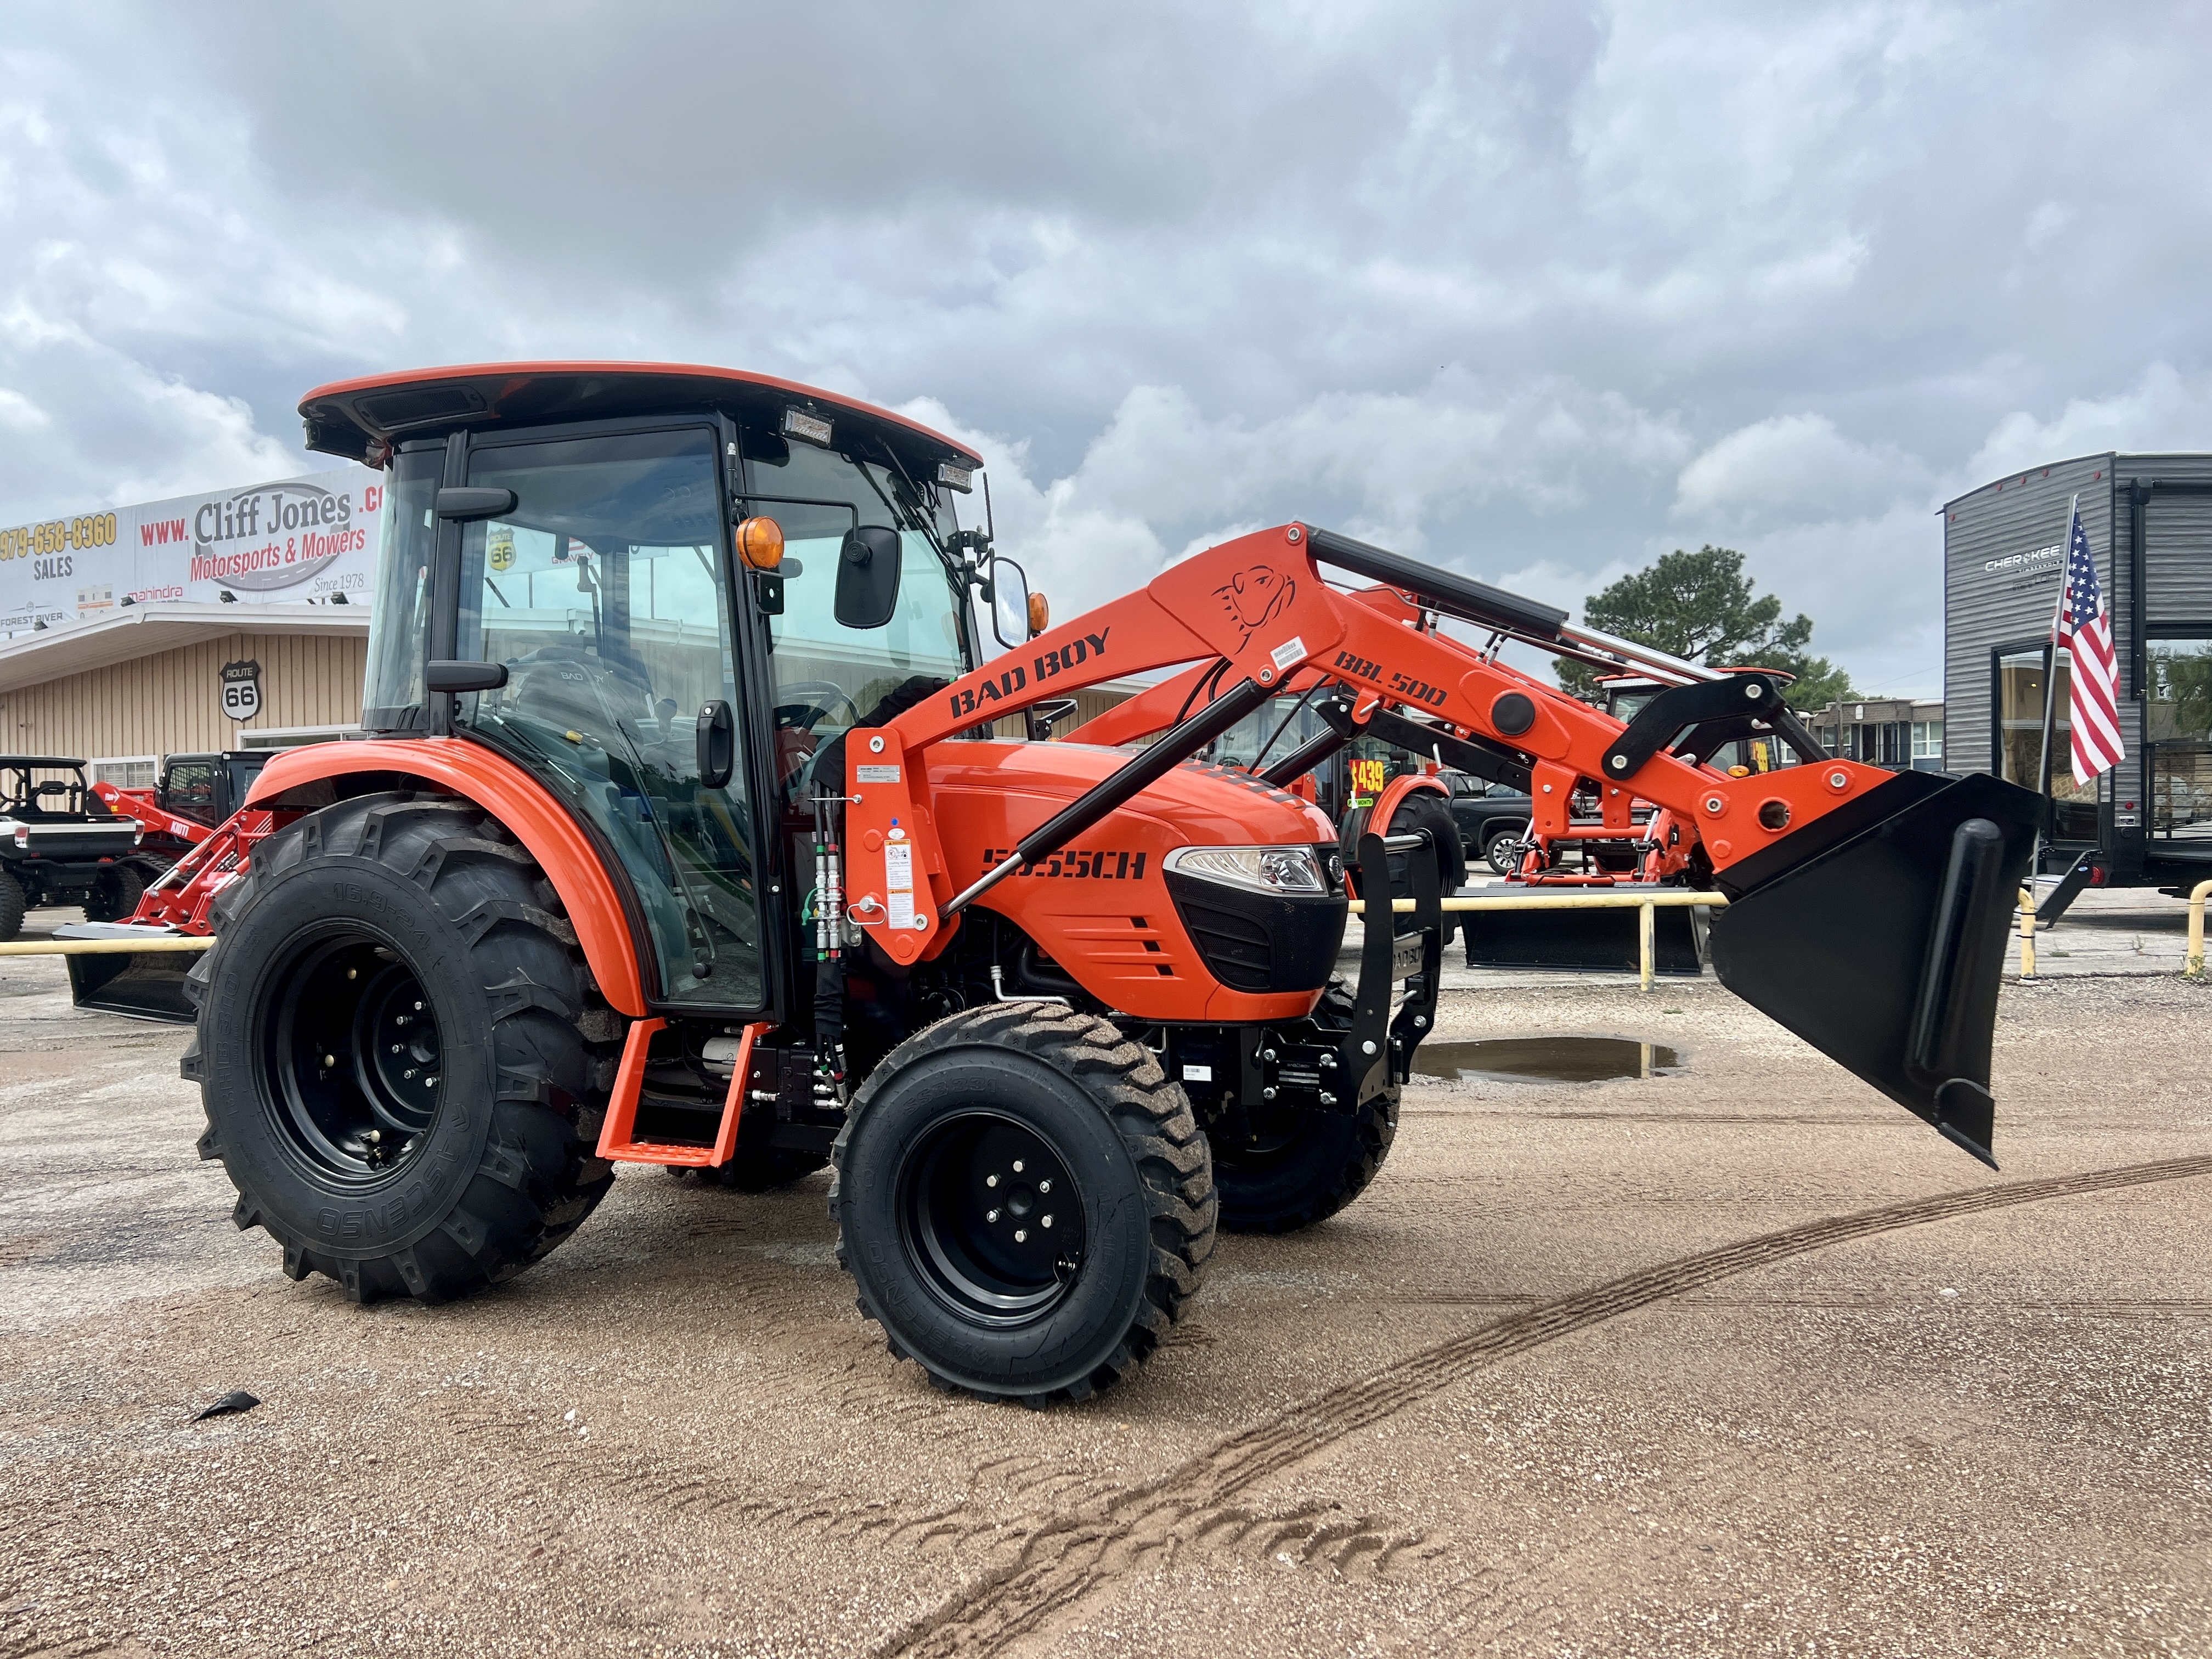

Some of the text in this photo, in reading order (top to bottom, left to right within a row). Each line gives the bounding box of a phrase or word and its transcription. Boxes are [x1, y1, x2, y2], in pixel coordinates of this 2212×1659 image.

[195, 495, 261, 543] Cliff
[268, 493, 351, 535] Jones
[0, 512, 116, 561] 979-658-8360
[190, 529, 365, 582] Motorsports & Mowers
[491, 546, 513, 563] 66
[34, 556, 72, 580] SALES
[2018, 560, 2061, 573] TIMBERWOLF
[314, 573, 364, 592] Since 1978
[128, 585, 183, 601] mahindra
[1, 612, 63, 627] FOREST RIVER
[226, 667, 253, 678] ROUTE
[561, 672, 583, 681] BAD
[950, 625, 1110, 719] BAD BOY
[1333, 651, 1383, 685] BBL
[1387, 673, 1448, 707] 500
[225, 686, 255, 708] 66
[170, 821, 190, 837] KIOTI
[332, 881, 432, 950] 16.9-24
